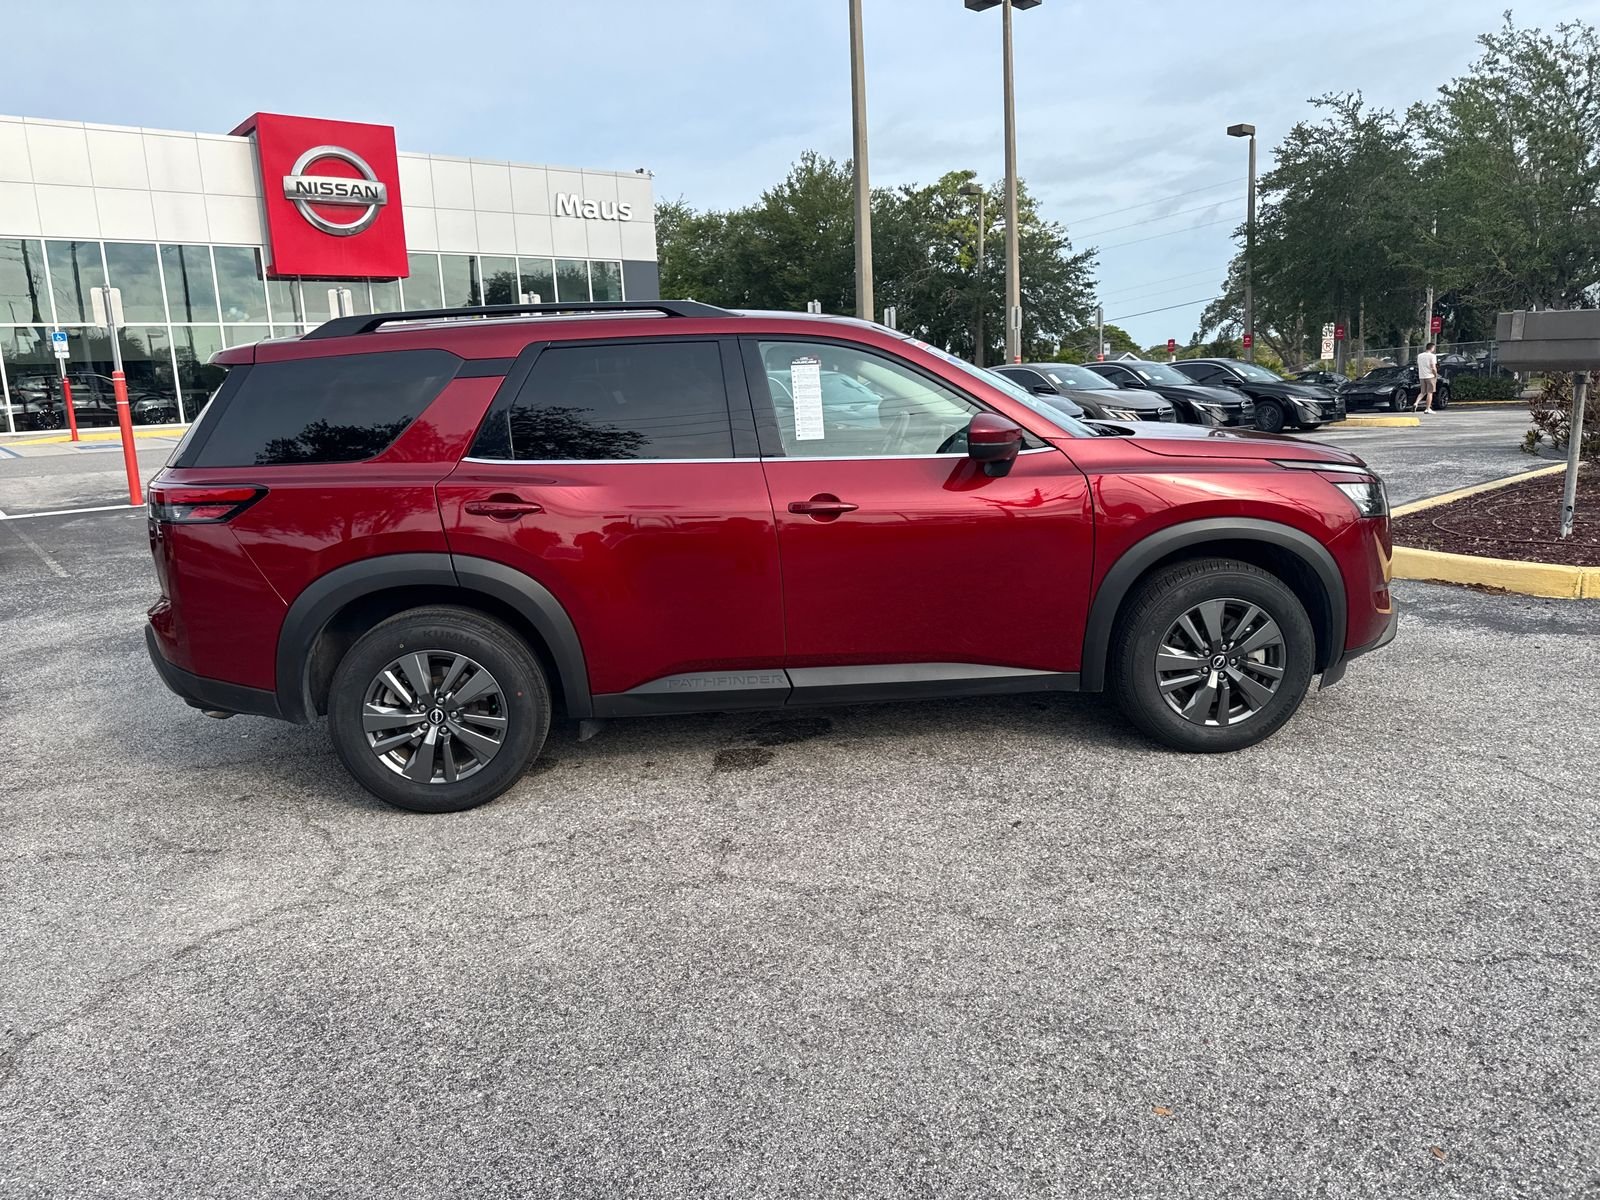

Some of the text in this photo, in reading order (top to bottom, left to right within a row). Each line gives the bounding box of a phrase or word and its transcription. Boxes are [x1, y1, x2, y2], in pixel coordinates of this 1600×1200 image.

[295, 181, 379, 199] NISSAN
[555, 192, 633, 222] Maus
[423, 630, 480, 648] KUMHO
[665, 674, 784, 689] PATHFINDER
